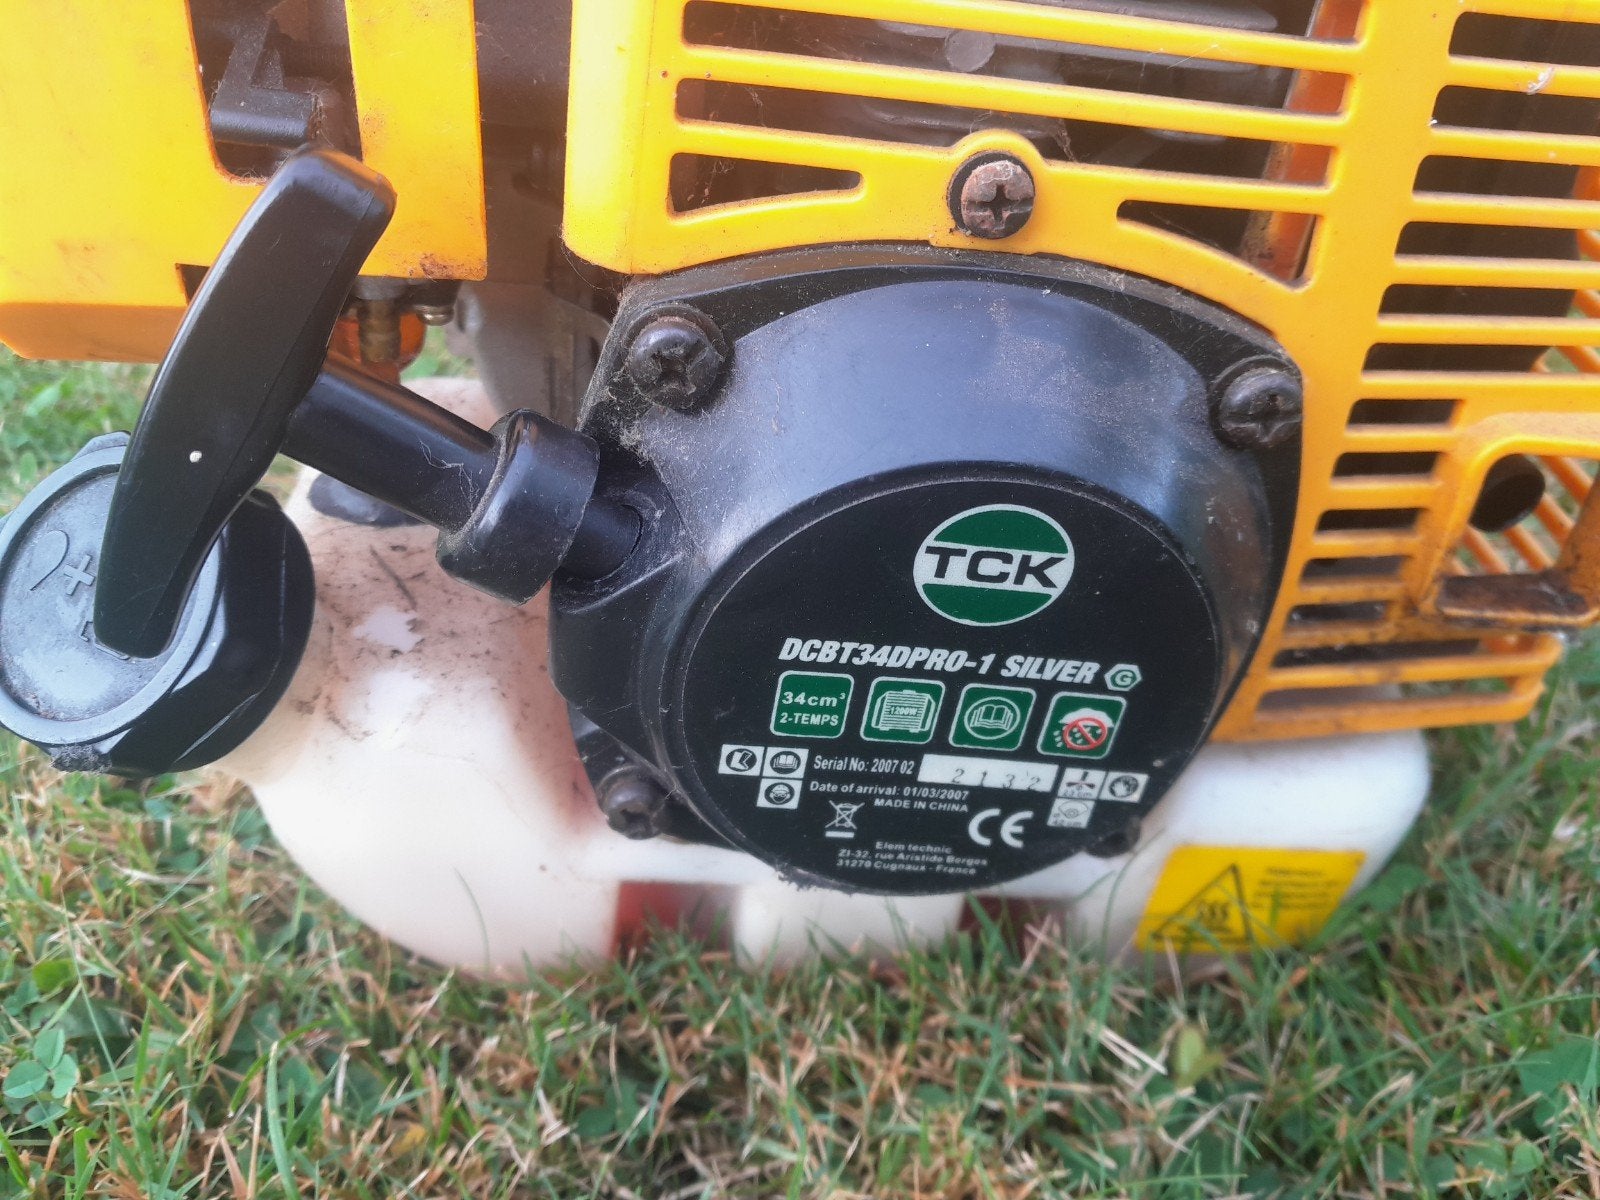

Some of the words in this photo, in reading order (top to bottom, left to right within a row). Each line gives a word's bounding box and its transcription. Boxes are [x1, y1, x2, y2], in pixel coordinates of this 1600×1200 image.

[925, 546, 1066, 589] TCK
[778, 637, 996, 675] DCBT34DPRO-1
[1001, 655, 1100, 684] SILVER
[780, 712, 839, 726] 2-TEMPS
[813, 755, 847, 771] Serial
[849, 758, 869, 772] No:
[871, 758, 899, 773] 2007
[900, 760, 915, 775] 02
[810, 781, 838, 792] Date
[841, 783, 854, 793] of
[857, 785, 900, 797] arrival:
[903, 787, 969, 800] 01/03/2007
[874, 798, 910, 809] MADE
[913, 800, 926, 810] IN
[929, 802, 969, 813] CHINA
[874, 852, 894, 860] rue
[907, 843, 952, 854] technic
[935, 864, 976, 875] France
